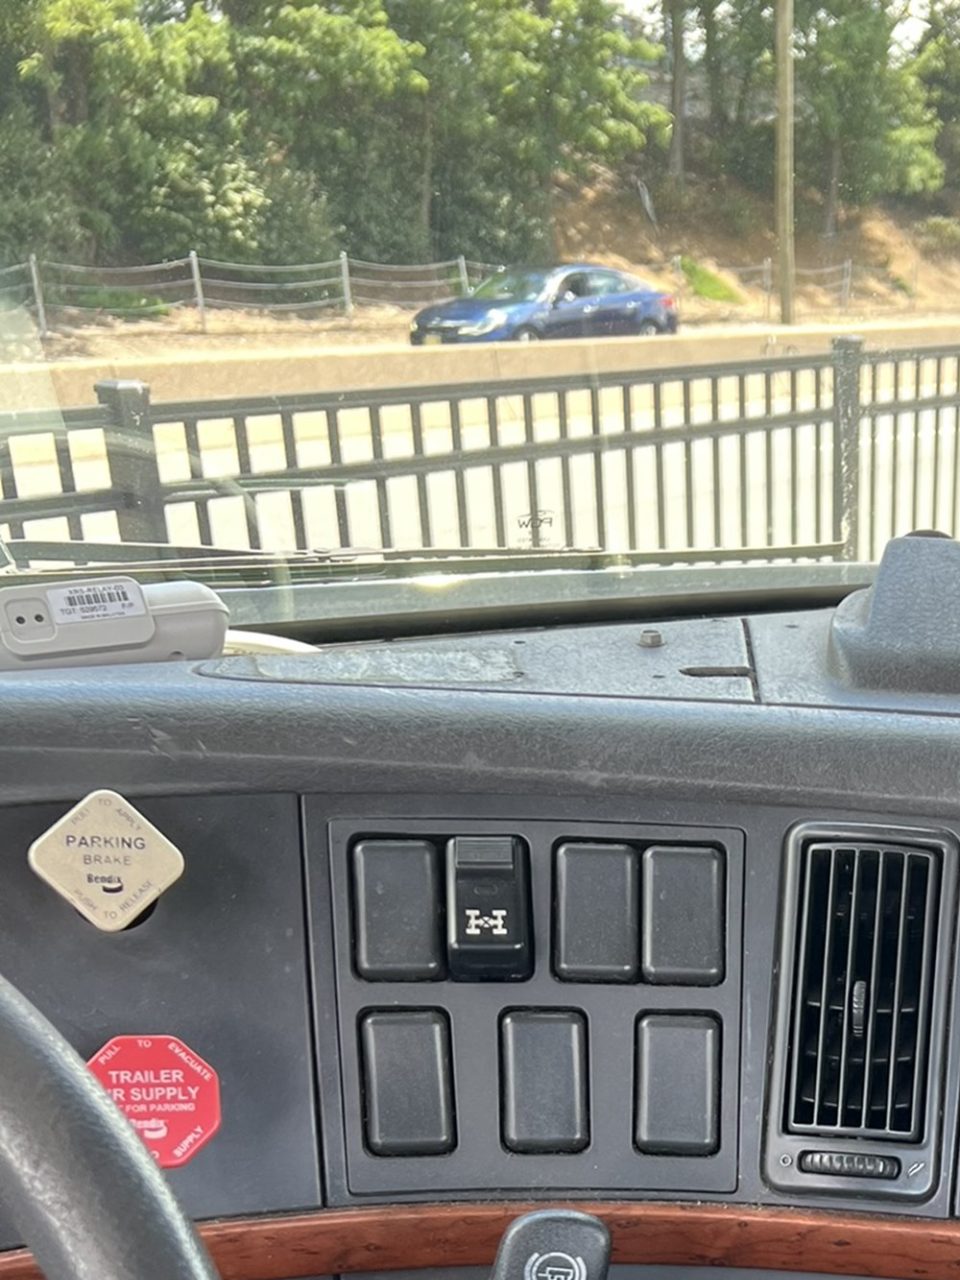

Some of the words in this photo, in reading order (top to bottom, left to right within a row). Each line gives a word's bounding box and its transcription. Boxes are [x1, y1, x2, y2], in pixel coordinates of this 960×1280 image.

[97, 798, 112, 807] TO
[115, 808, 142, 831] APPLY
[65, 834, 146, 850] PARKING
[83, 854, 132, 866] BRAKE
[87, 873, 122, 884] Bendix
[103, 910, 118, 919] TO
[98, 1045, 122, 1065] PULL
[136, 1039, 152, 1048] TO
[167, 1042, 213, 1082] EVACUATE
[108, 1070, 185, 1084] TRAILER
[130, 1086, 200, 1101] SUPPLY
[125, 1104, 147, 1112] FOR
[149, 1103, 196, 1112] PARKING
[172, 1125, 204, 1158] SUPPLY
